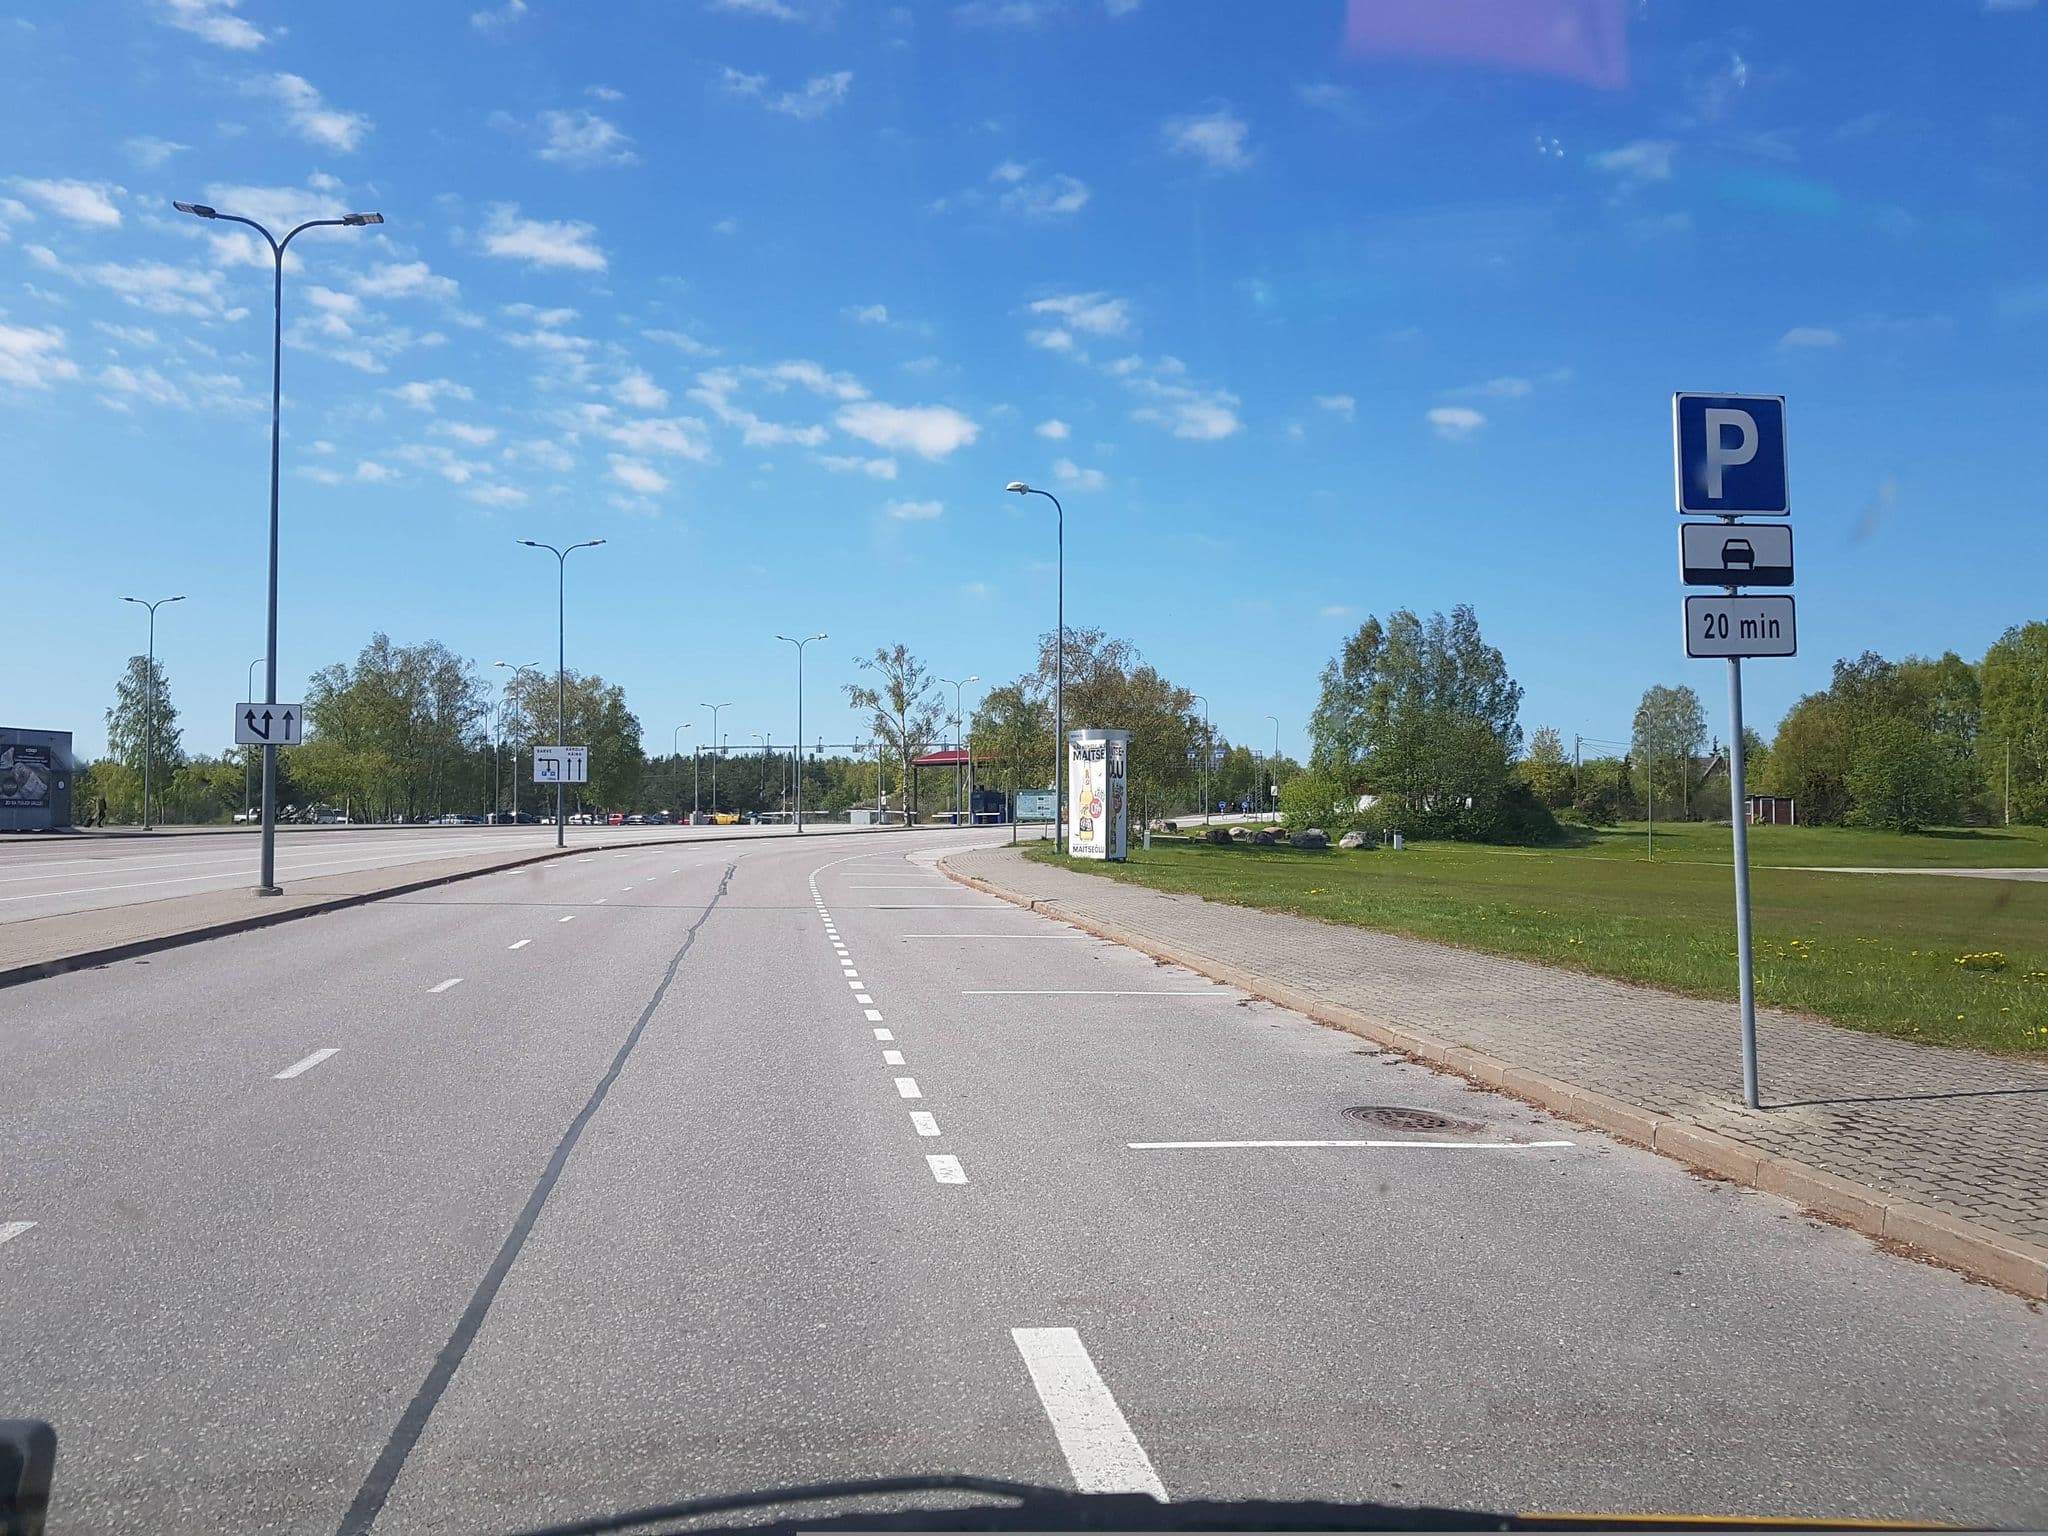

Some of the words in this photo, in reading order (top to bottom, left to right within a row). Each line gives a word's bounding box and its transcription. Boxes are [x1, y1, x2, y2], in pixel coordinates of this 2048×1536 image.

[1705, 408, 1759, 499] P
[1703, 613, 1729, 640] 20
[1740, 613, 1780, 640] min
[1073, 749, 1105, 761] MAITSE
